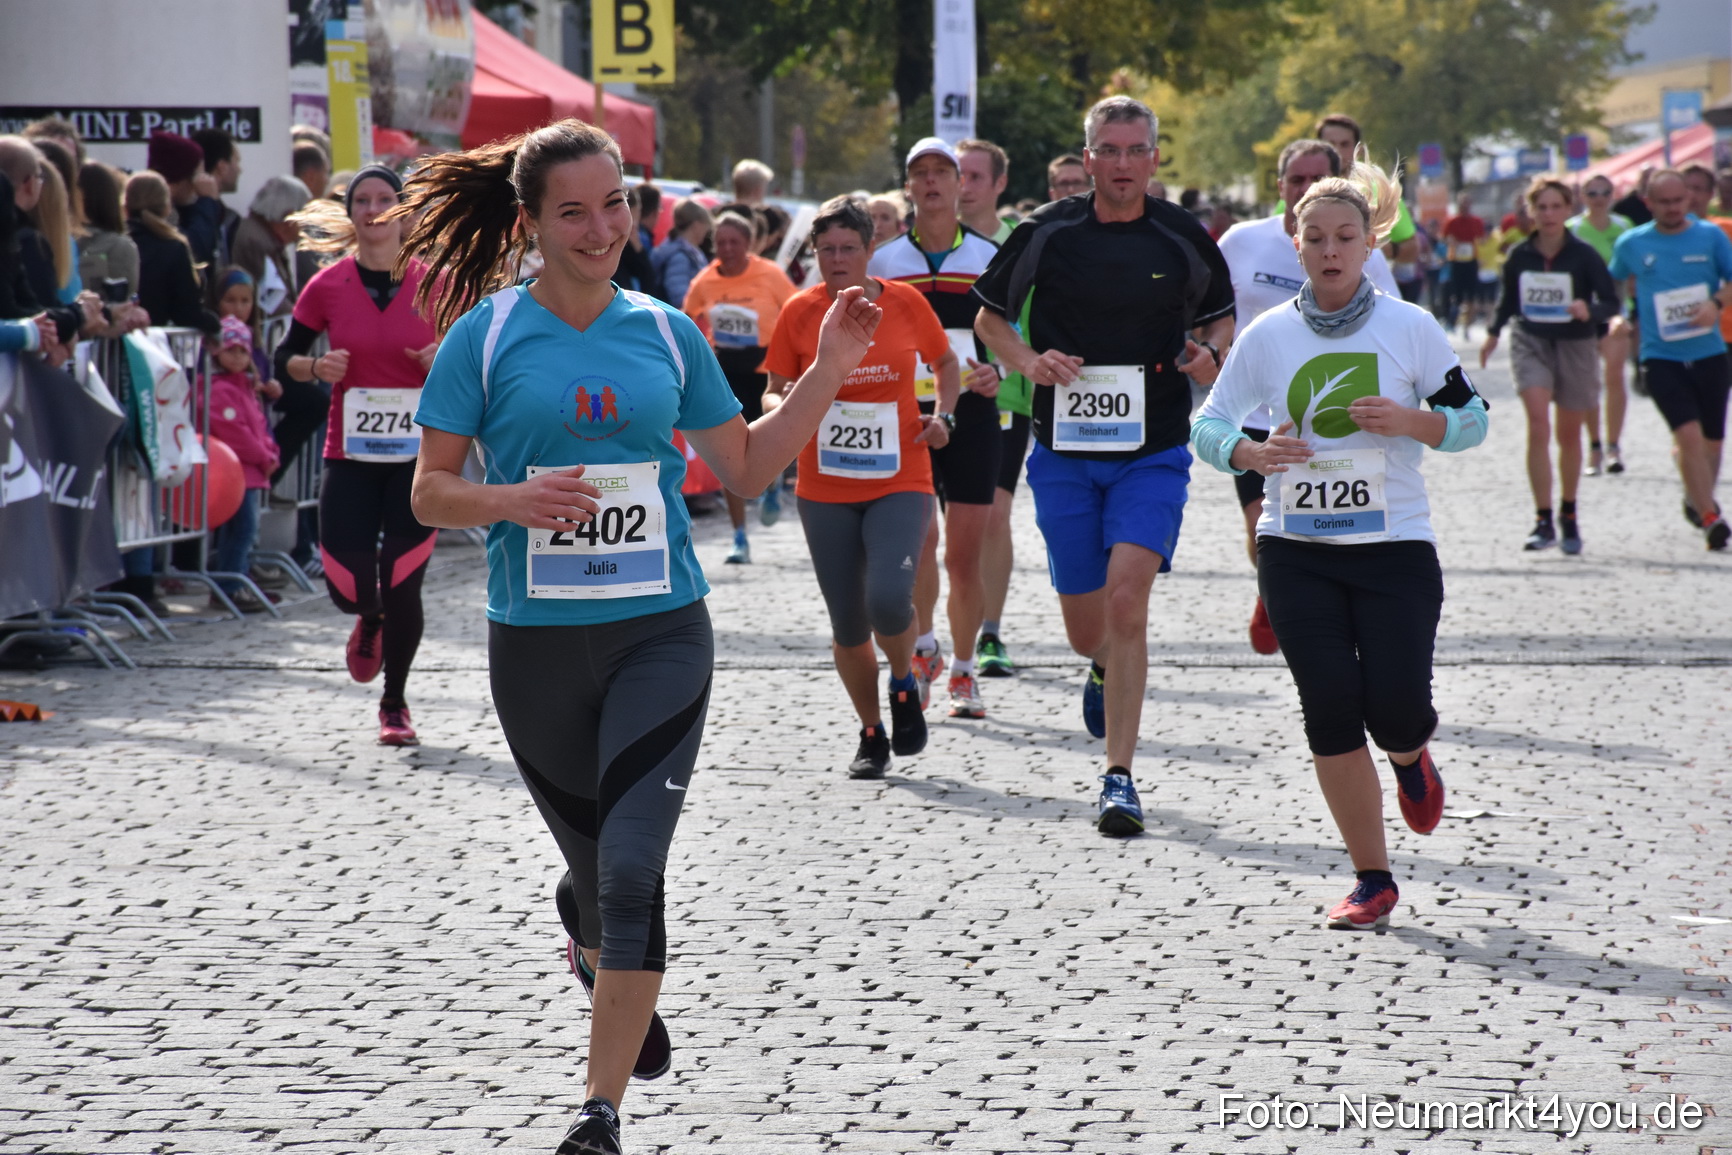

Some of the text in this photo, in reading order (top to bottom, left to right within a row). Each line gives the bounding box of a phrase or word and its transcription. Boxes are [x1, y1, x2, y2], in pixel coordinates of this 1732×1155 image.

[615, 0, 653, 54] B
[848, 364, 889, 377] nners
[1068, 392, 1130, 418] 2390
[356, 411, 413, 433] 2274
[829, 425, 883, 449] 2231
[1078, 427, 1119, 436] Reinhard
[840, 456, 877, 466] Michaela
[1295, 480, 1370, 509] 2126
[1314, 519, 1354, 529] Corinna
[584, 561, 617, 576] Julia
